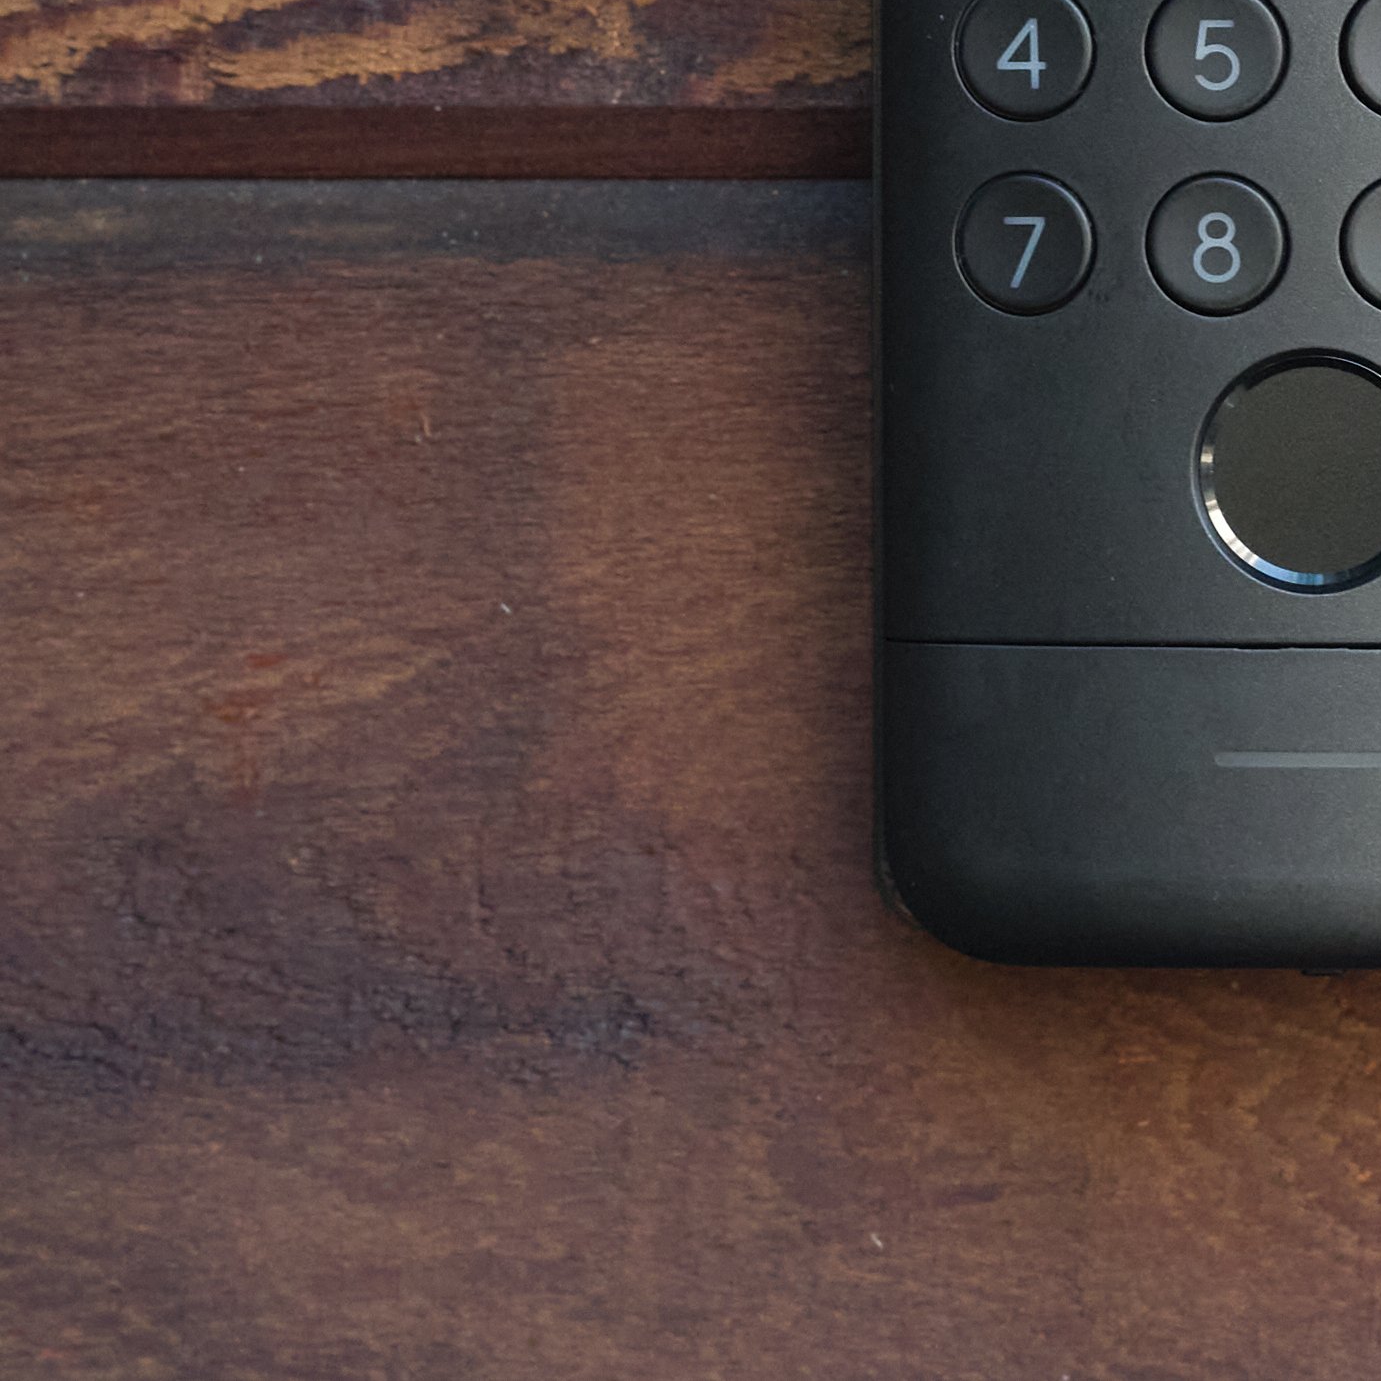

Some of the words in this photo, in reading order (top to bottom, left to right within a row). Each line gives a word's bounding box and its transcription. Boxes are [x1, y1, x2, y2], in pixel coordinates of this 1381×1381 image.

[996, 18, 1047, 90] 4
[1194, 19, 1241, 91] 5
[1003, 216, 1046, 289] 7
[1192, 212, 1241, 284] 8
